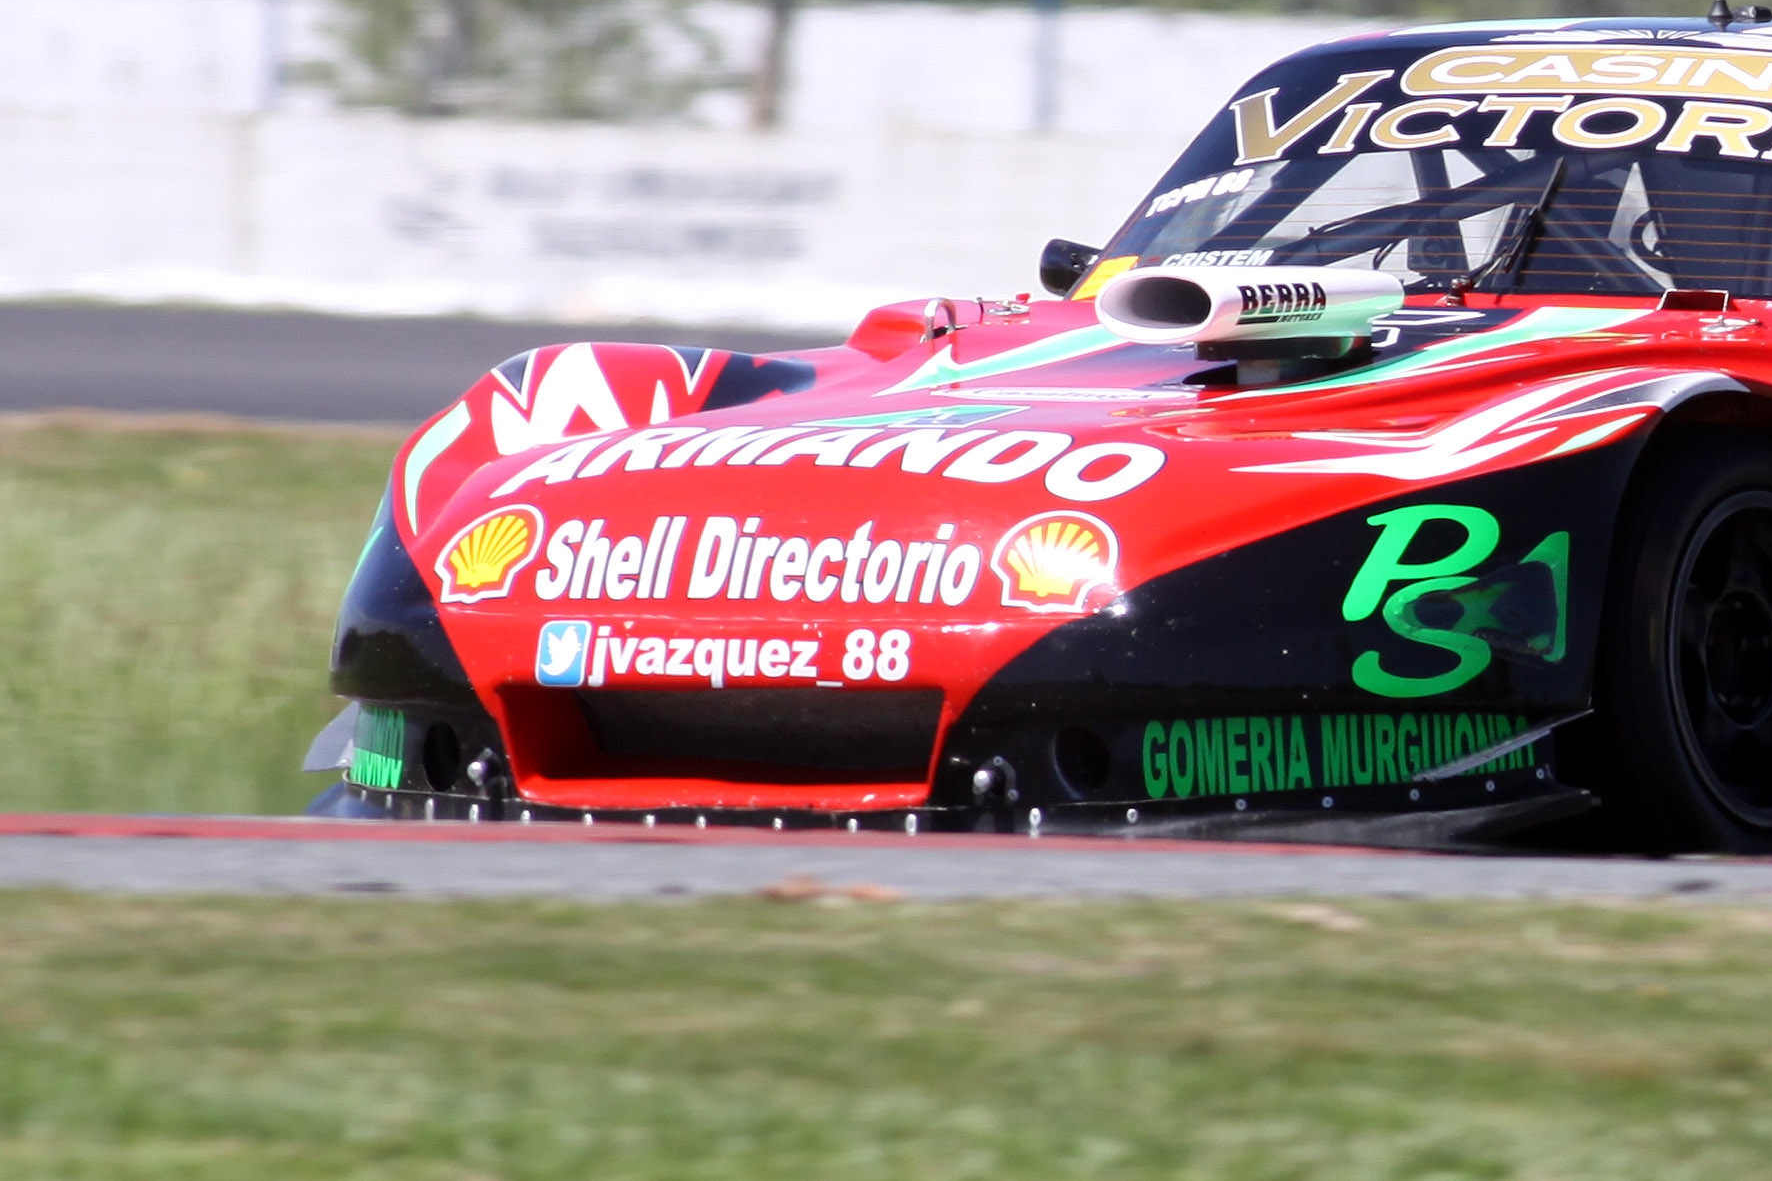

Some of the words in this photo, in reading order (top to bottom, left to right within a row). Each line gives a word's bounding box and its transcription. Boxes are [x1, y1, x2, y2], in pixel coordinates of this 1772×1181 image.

[1236, 282, 1327, 315] BERRA
[489, 425, 1167, 502] ARMANDO
[535, 515, 689, 601] Shell
[686, 515, 984, 607] Directorio
[588, 626, 911, 688] jvazquez_88
[1142, 716, 1313, 800] GOMERIA
